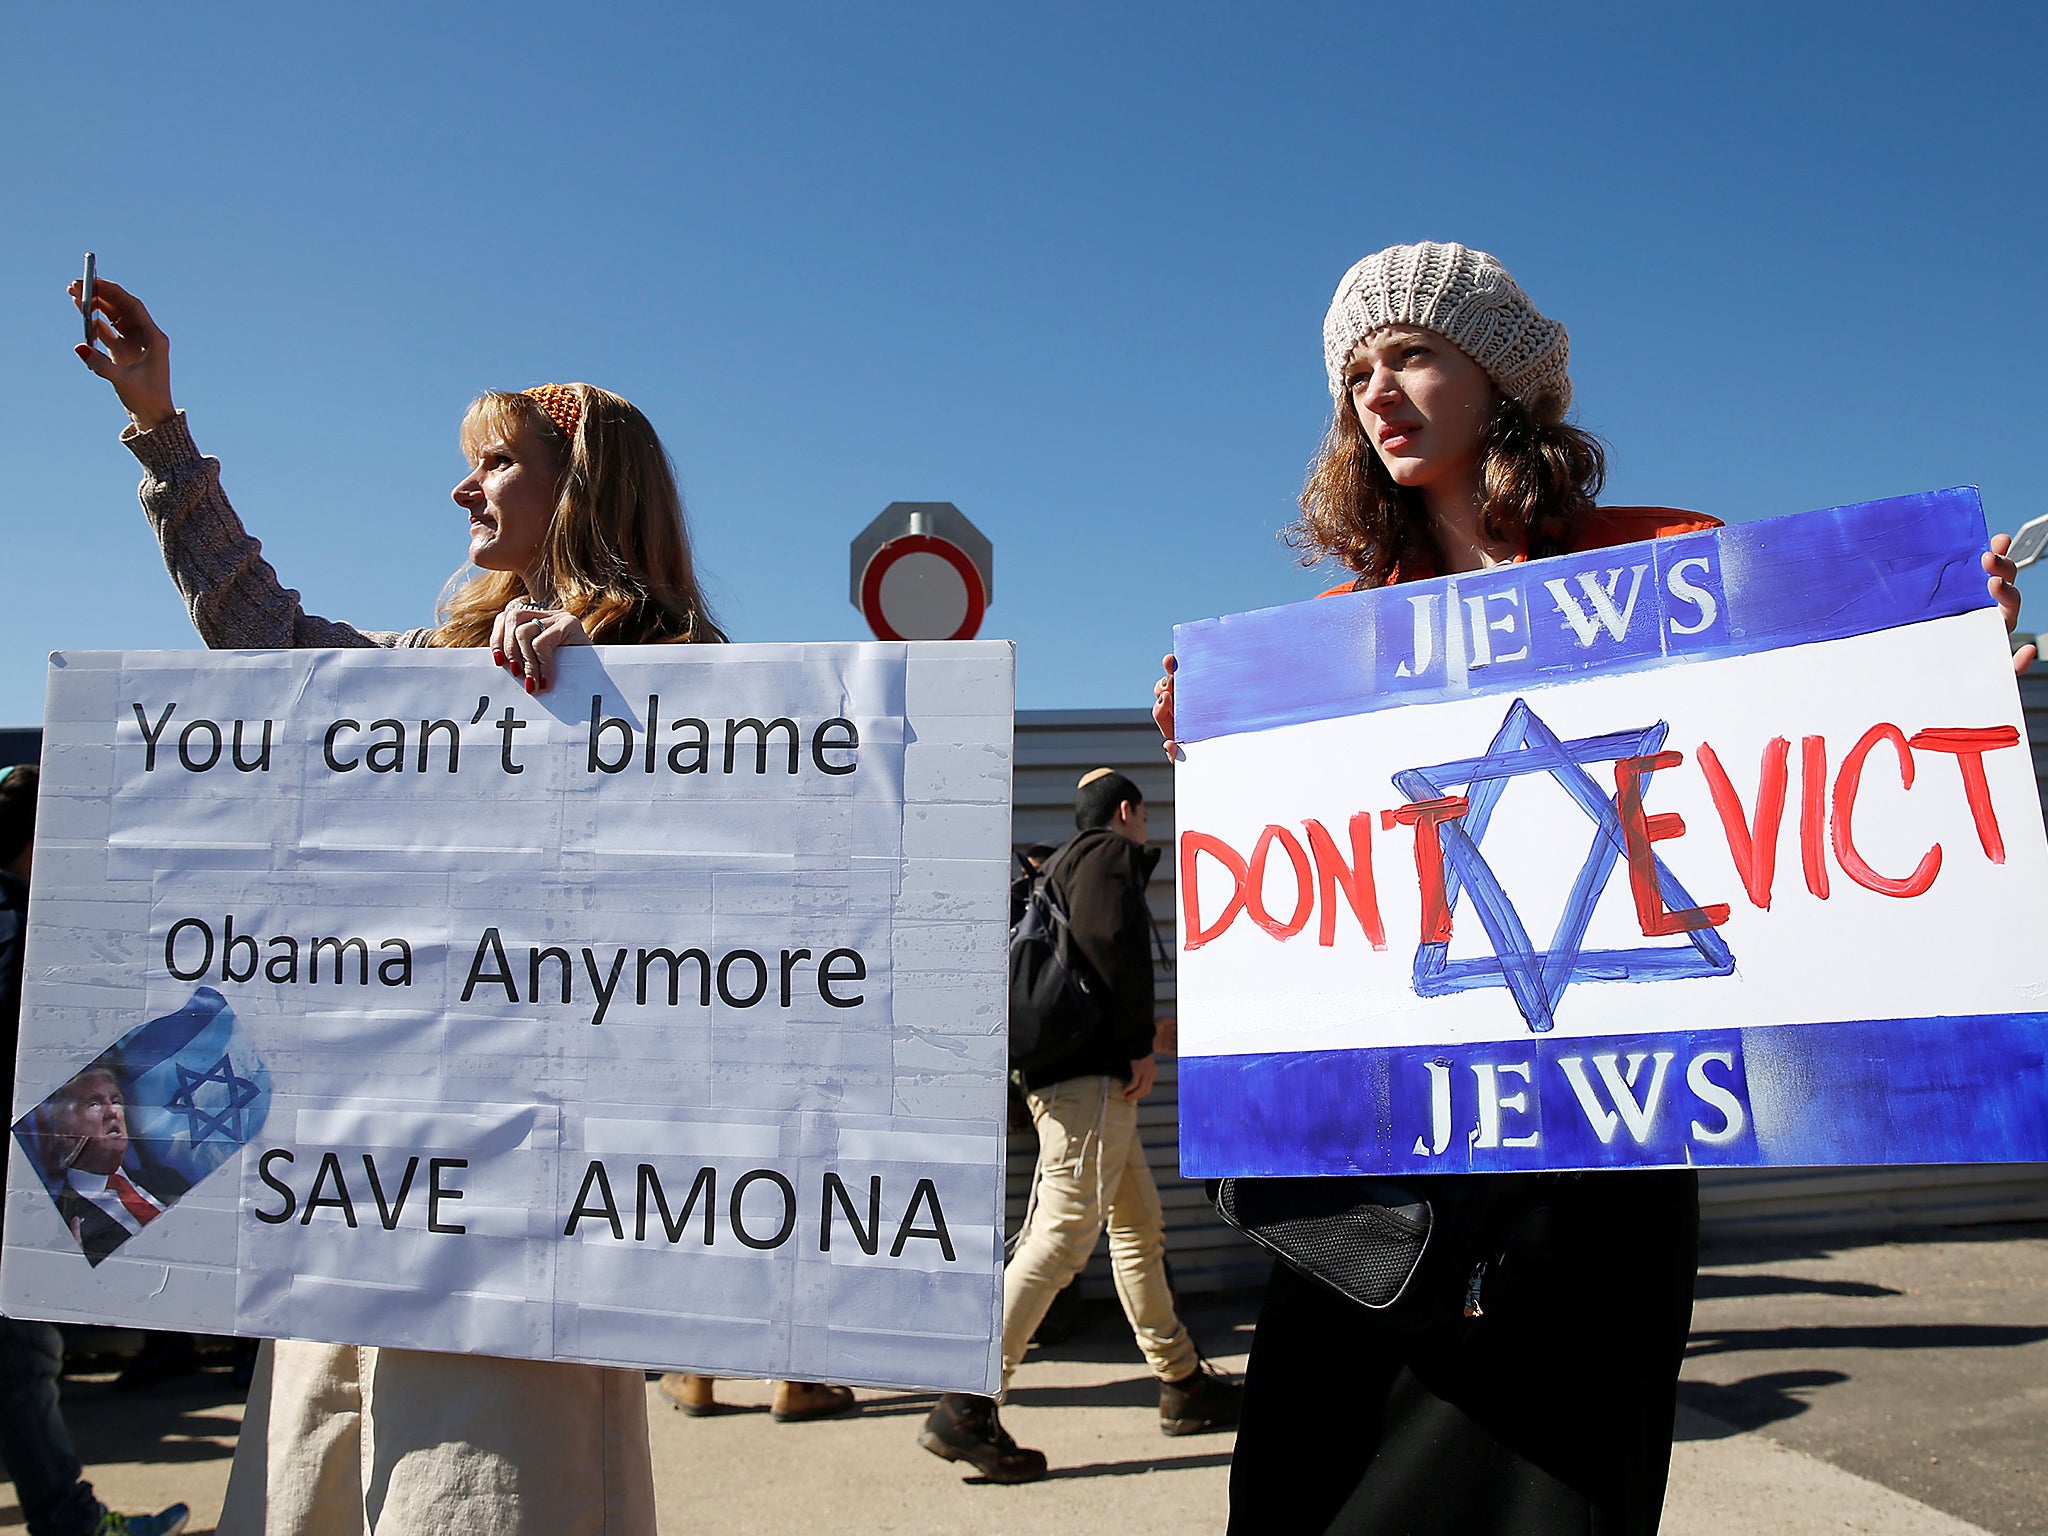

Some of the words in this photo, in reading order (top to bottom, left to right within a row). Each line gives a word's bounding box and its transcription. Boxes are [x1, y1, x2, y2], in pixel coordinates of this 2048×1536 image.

[1396, 556, 1721, 679] JEWS
[132, 702, 273, 773] You
[323, 695, 527, 775] can't
[587, 694, 860, 776] blame
[1614, 721, 2020, 937] EVICT
[164, 914, 412, 987] Obama
[460, 927, 867, 1026] Anymore
[1412, 1051, 1747, 1157] JEWS
[254, 1148, 469, 1235] SAVE
[563, 1160, 957, 1262] AMONA
